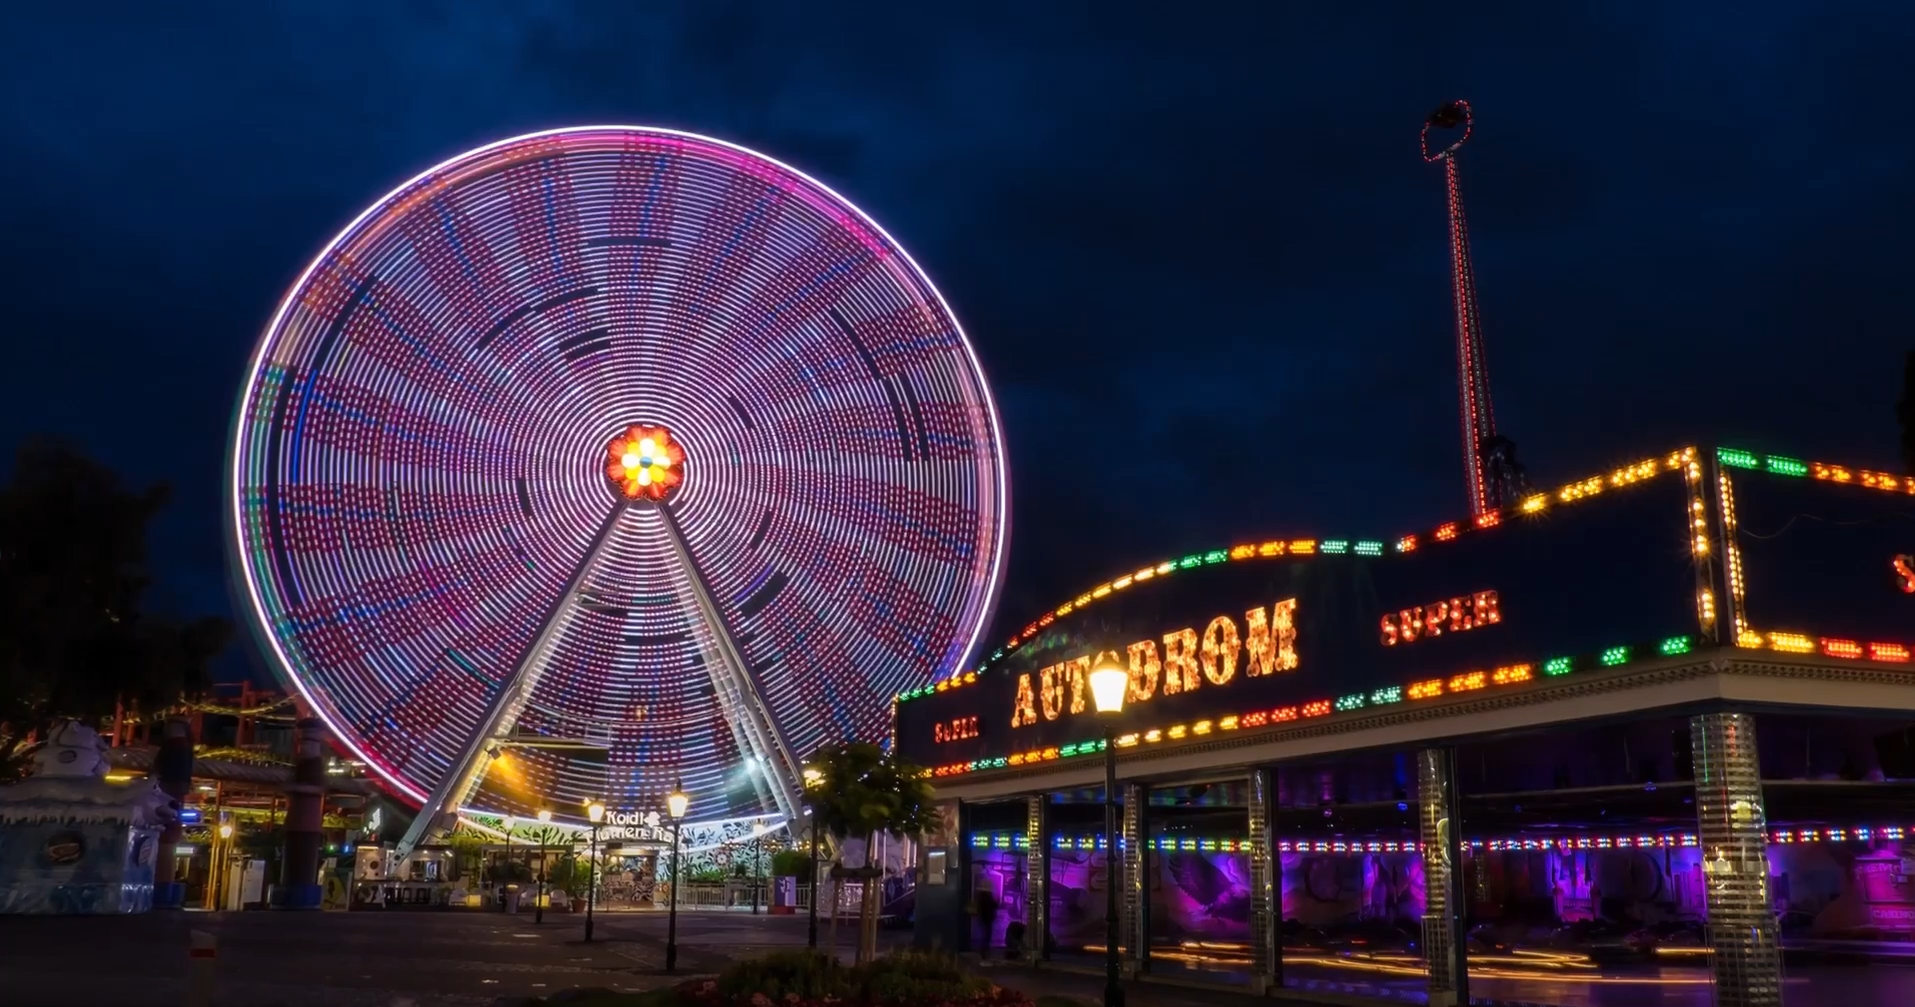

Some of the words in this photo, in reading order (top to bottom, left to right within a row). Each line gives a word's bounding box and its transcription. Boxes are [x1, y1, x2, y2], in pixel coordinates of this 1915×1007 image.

[935, 715, 979, 743] SUPER
[1379, 589, 1501, 646] SUPER
[605, 810, 645, 825] Koidl
